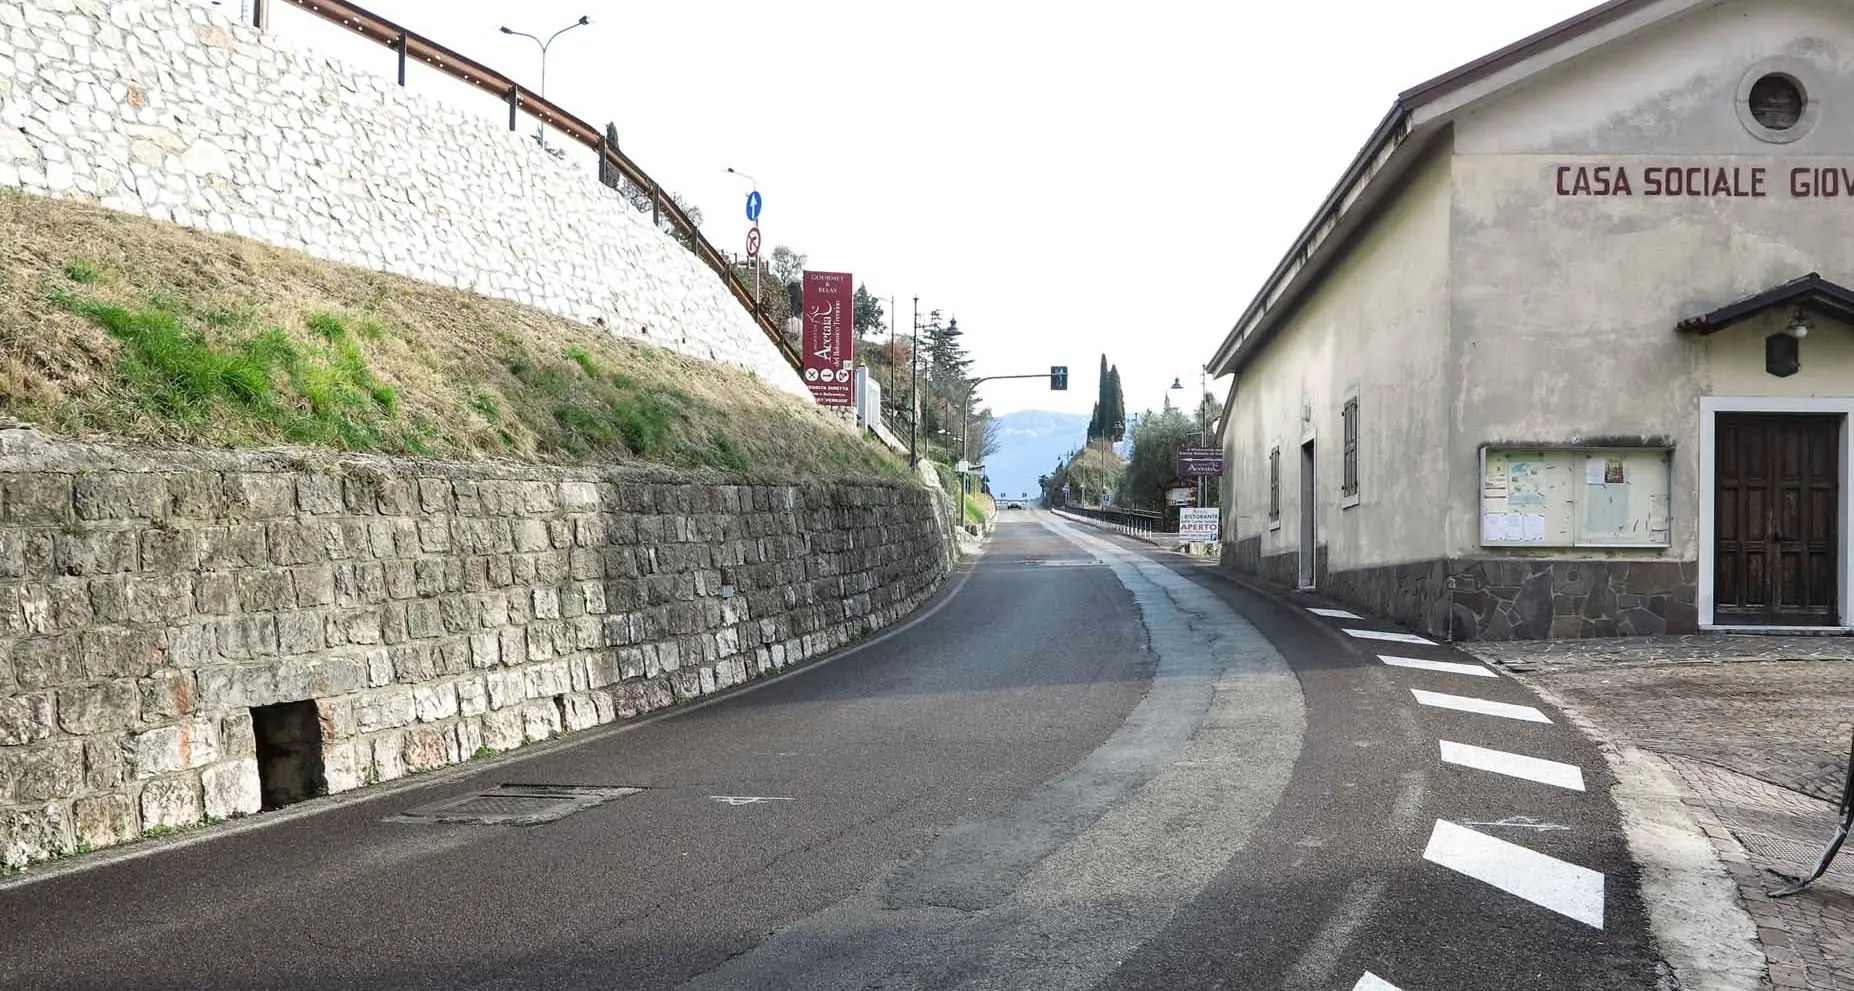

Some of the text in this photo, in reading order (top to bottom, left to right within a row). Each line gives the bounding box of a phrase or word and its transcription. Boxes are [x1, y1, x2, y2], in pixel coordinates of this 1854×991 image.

[1556, 166, 1854, 197] CASA SOCIALE GIOV
[813, 316, 832, 363] Acetaia
